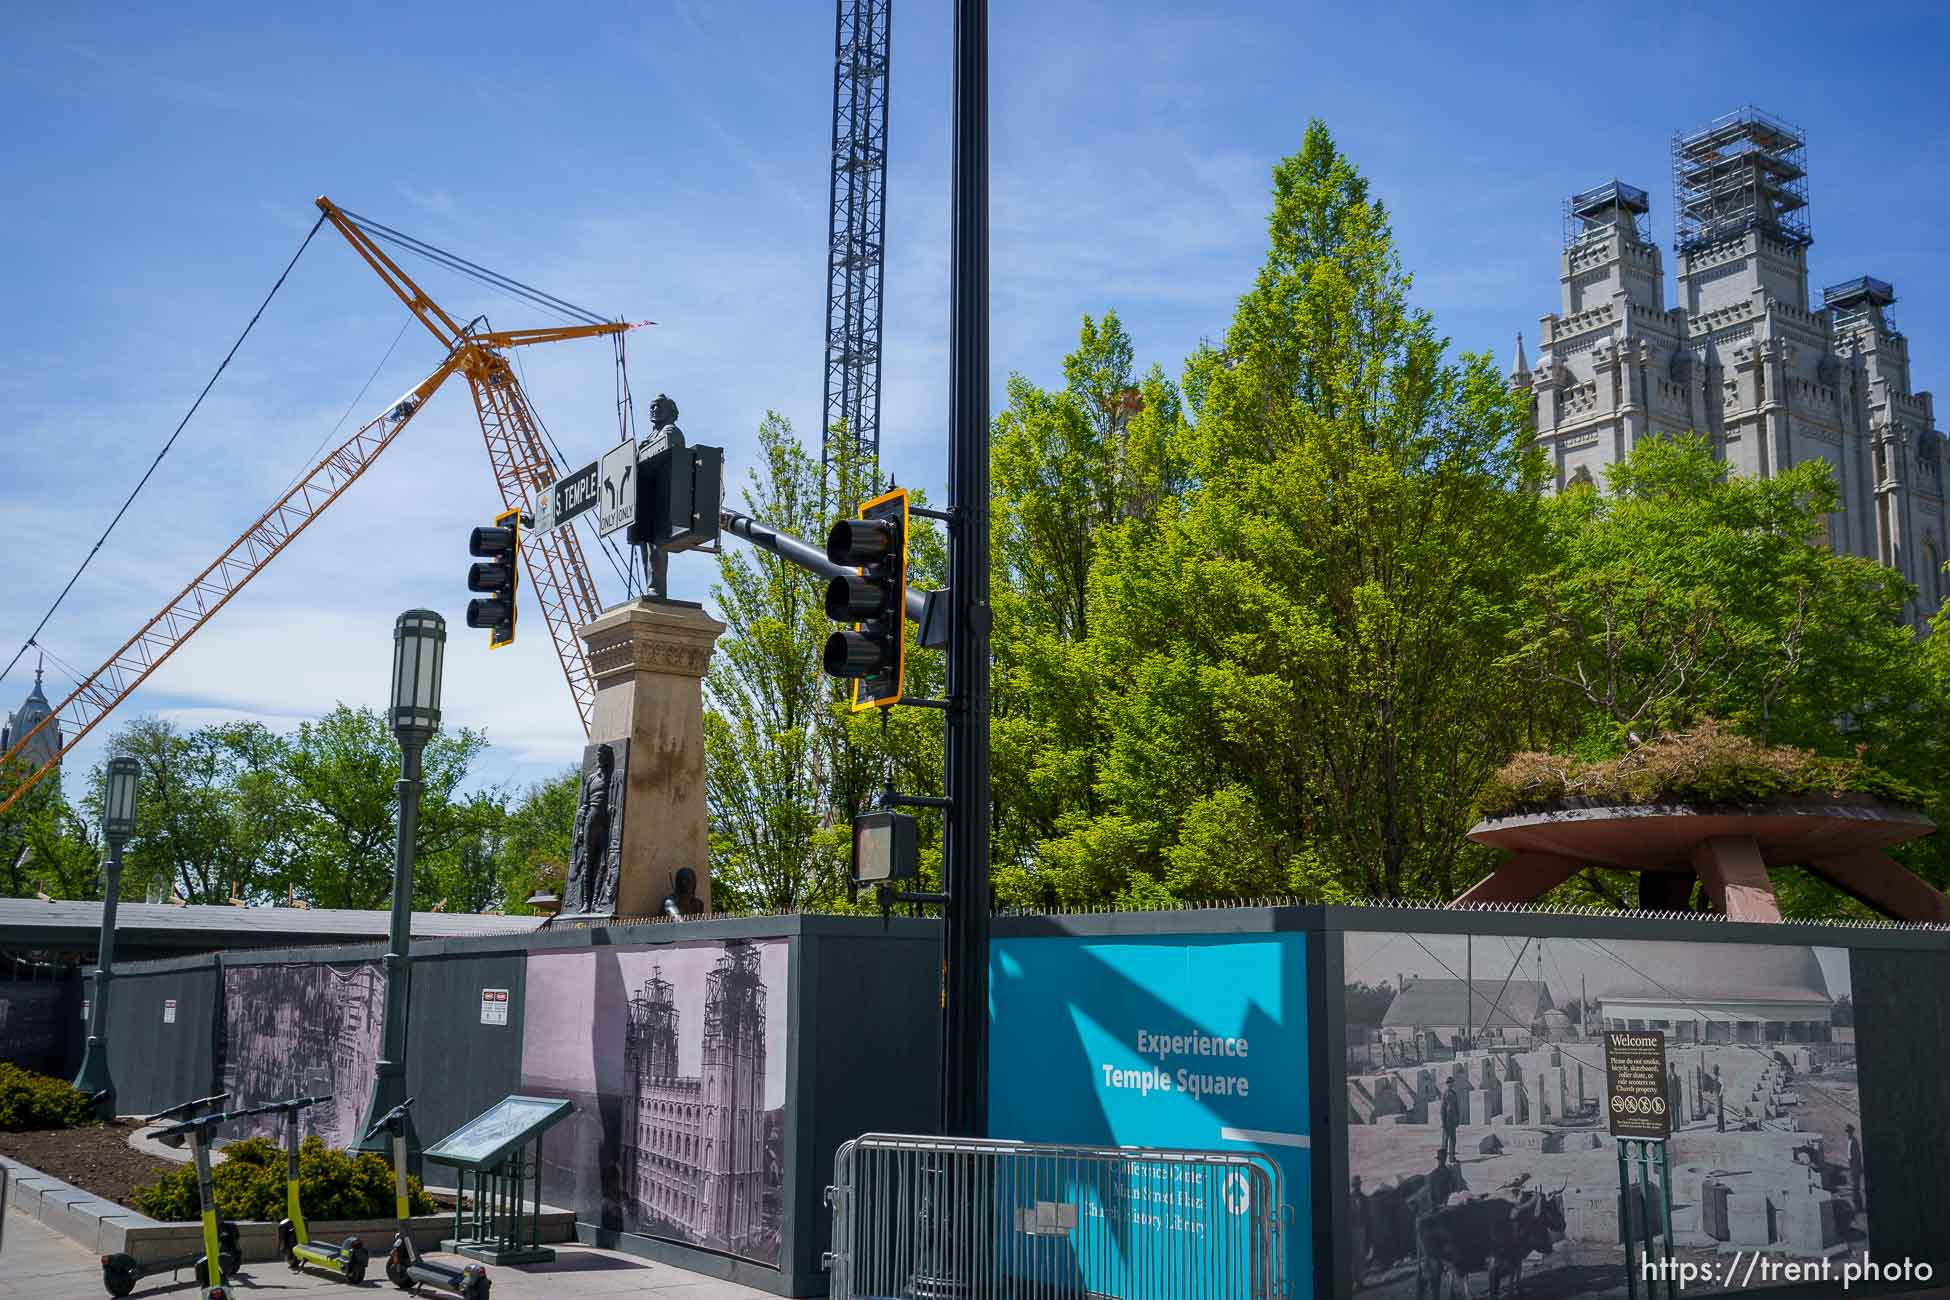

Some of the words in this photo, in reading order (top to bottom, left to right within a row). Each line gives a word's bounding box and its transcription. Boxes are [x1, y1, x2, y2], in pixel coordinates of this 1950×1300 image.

[555, 491, 563, 517] S.
[564, 472, 597, 512] TEMPLE
[601, 511, 617, 531] ONLY
[618, 504, 634, 522] ONLY
[1137, 1029, 1249, 1061] Experience
[1610, 1033, 1657, 1047] Welcome
[1102, 1063, 1172, 1097] Temple
[1176, 1068, 1249, 1101] Square
